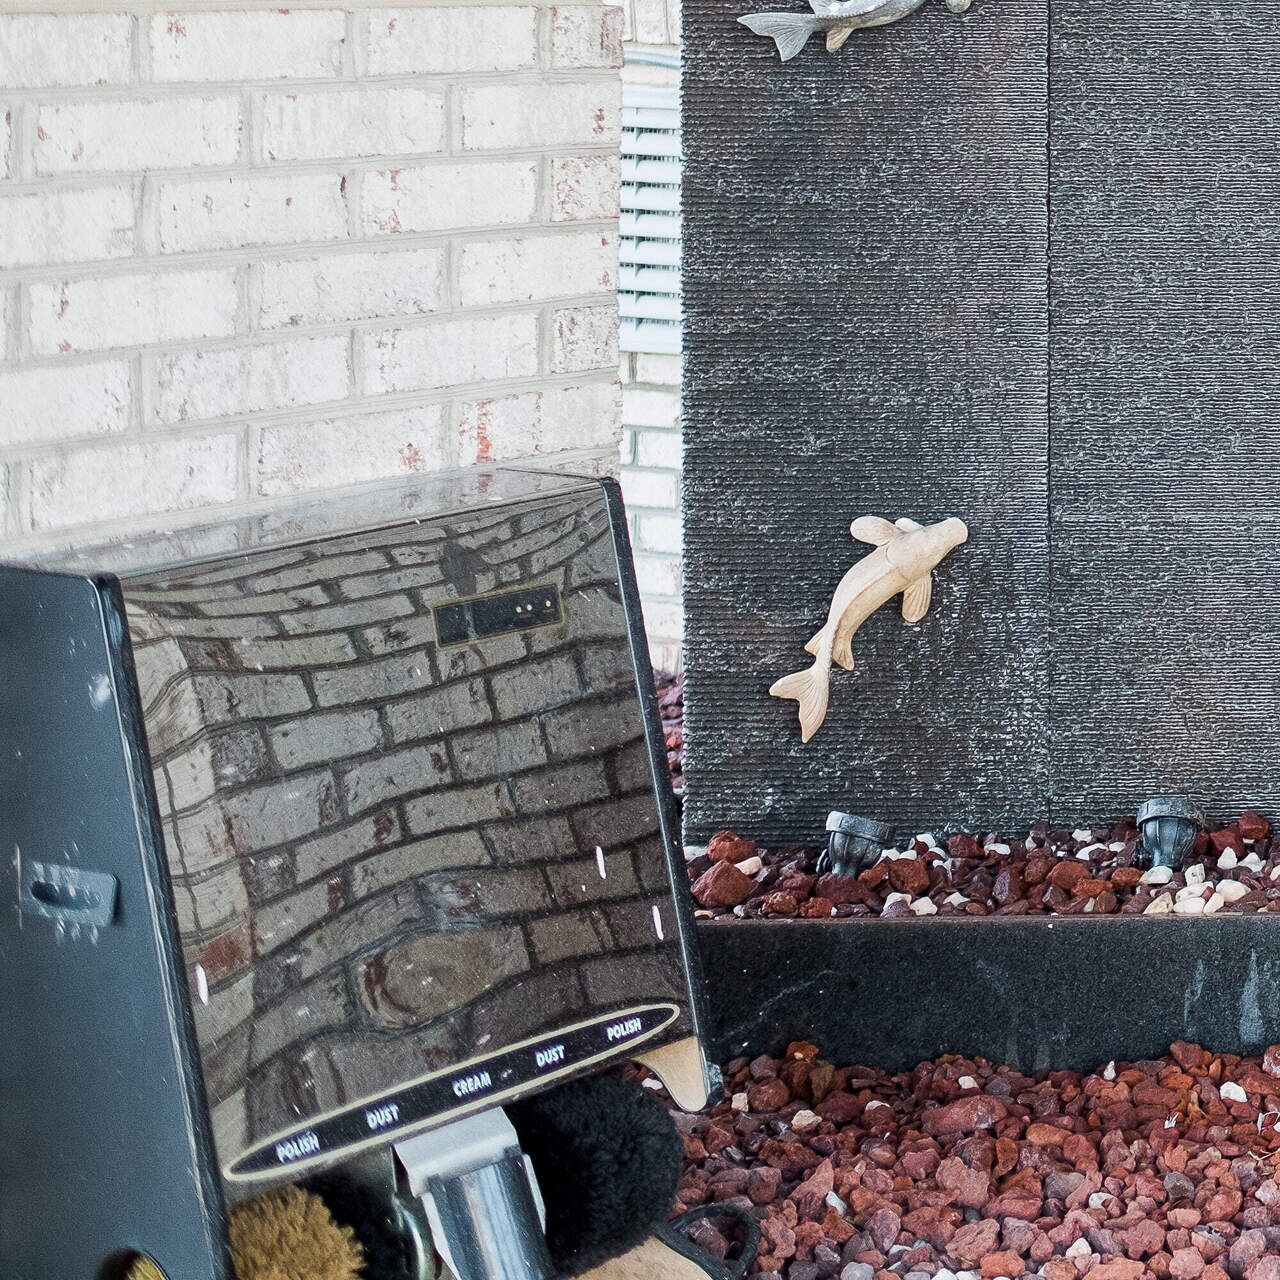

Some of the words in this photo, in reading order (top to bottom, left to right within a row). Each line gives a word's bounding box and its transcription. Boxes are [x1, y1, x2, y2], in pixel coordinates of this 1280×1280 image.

[275, 1131, 320, 1163] POLISH
[366, 1104, 400, 1130] DUST
[452, 1072, 492, 1097] CREAM
[536, 1046, 565, 1067] DUST
[606, 1018, 643, 1041] POLISH
